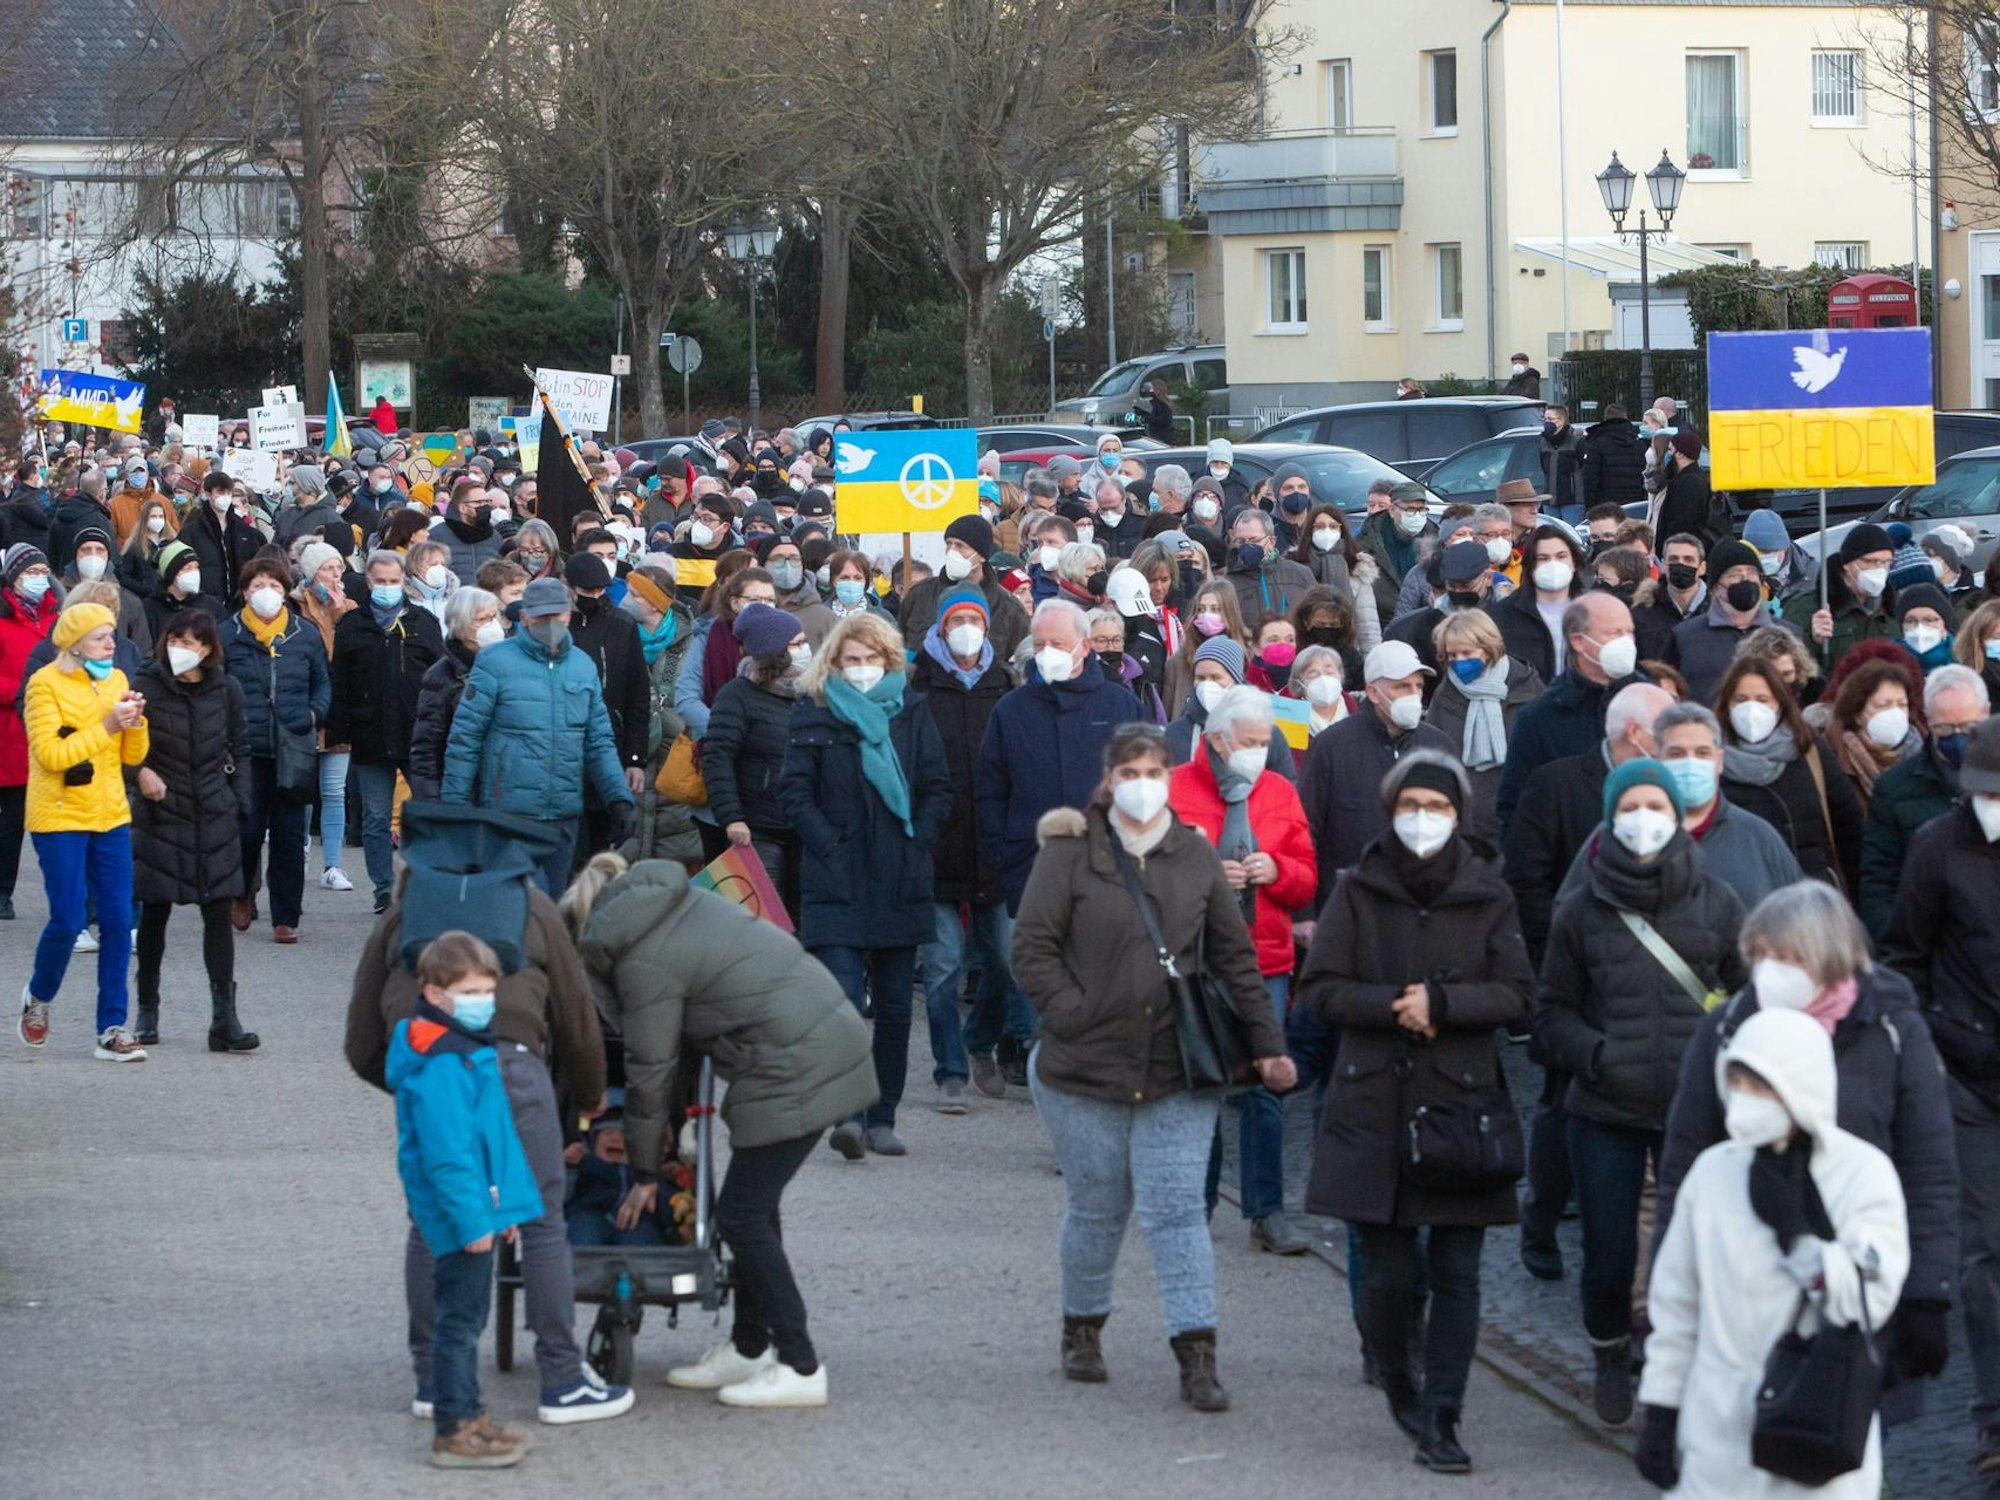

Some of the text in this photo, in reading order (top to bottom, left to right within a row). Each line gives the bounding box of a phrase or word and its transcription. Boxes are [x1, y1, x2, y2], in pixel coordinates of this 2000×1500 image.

[69, 322, 80, 341] P
[572, 377, 608, 399] STOP
[260, 439, 291, 449] Frieden
